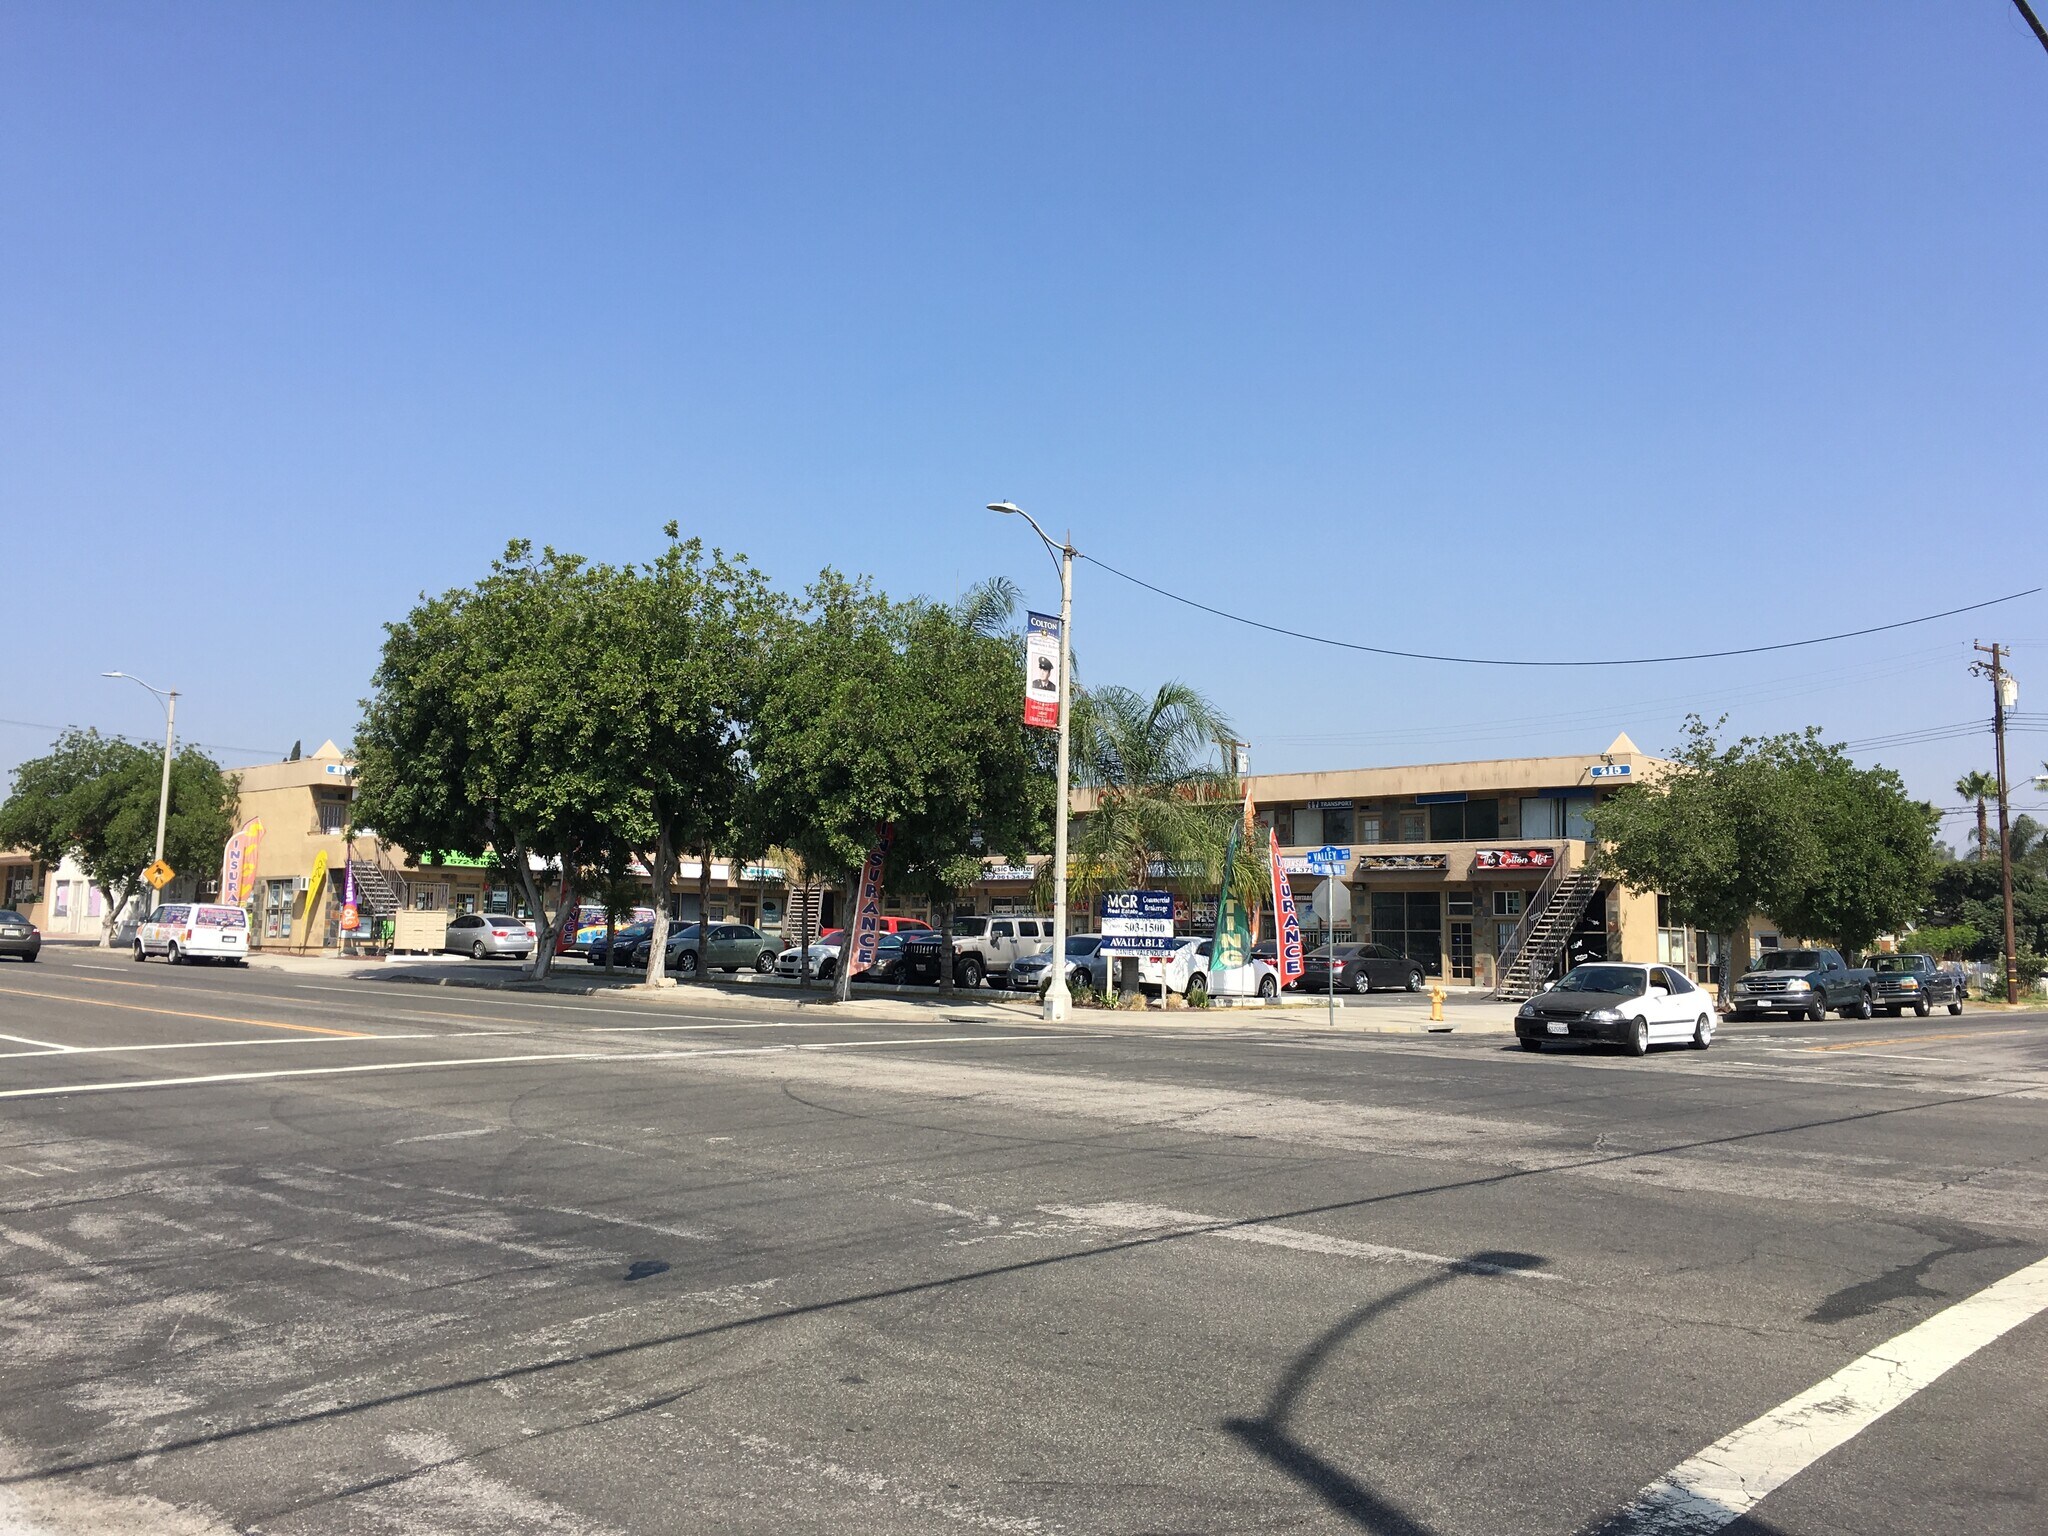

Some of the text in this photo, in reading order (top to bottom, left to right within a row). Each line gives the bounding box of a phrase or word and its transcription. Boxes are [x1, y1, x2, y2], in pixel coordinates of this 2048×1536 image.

[1031, 617, 1057, 630] COLTON
[1313, 851, 1337, 862] VALLEY
[1480, 854, 1496, 865] The
[228, 840, 240, 904] INSURA
[858, 822, 889, 963] INSURANCE
[1107, 894, 1138, 909] MGR
[1142, 896, 1171, 904] Commercial
[1144, 904, 1168, 913] Brokerage
[1273, 840, 1301, 974] INSURANCE
[1124, 922, 1166, 933] 503-1500
[1110, 937, 1165, 948] AVAILABLE
[1136, 949, 1171, 957] VALENZUELA
